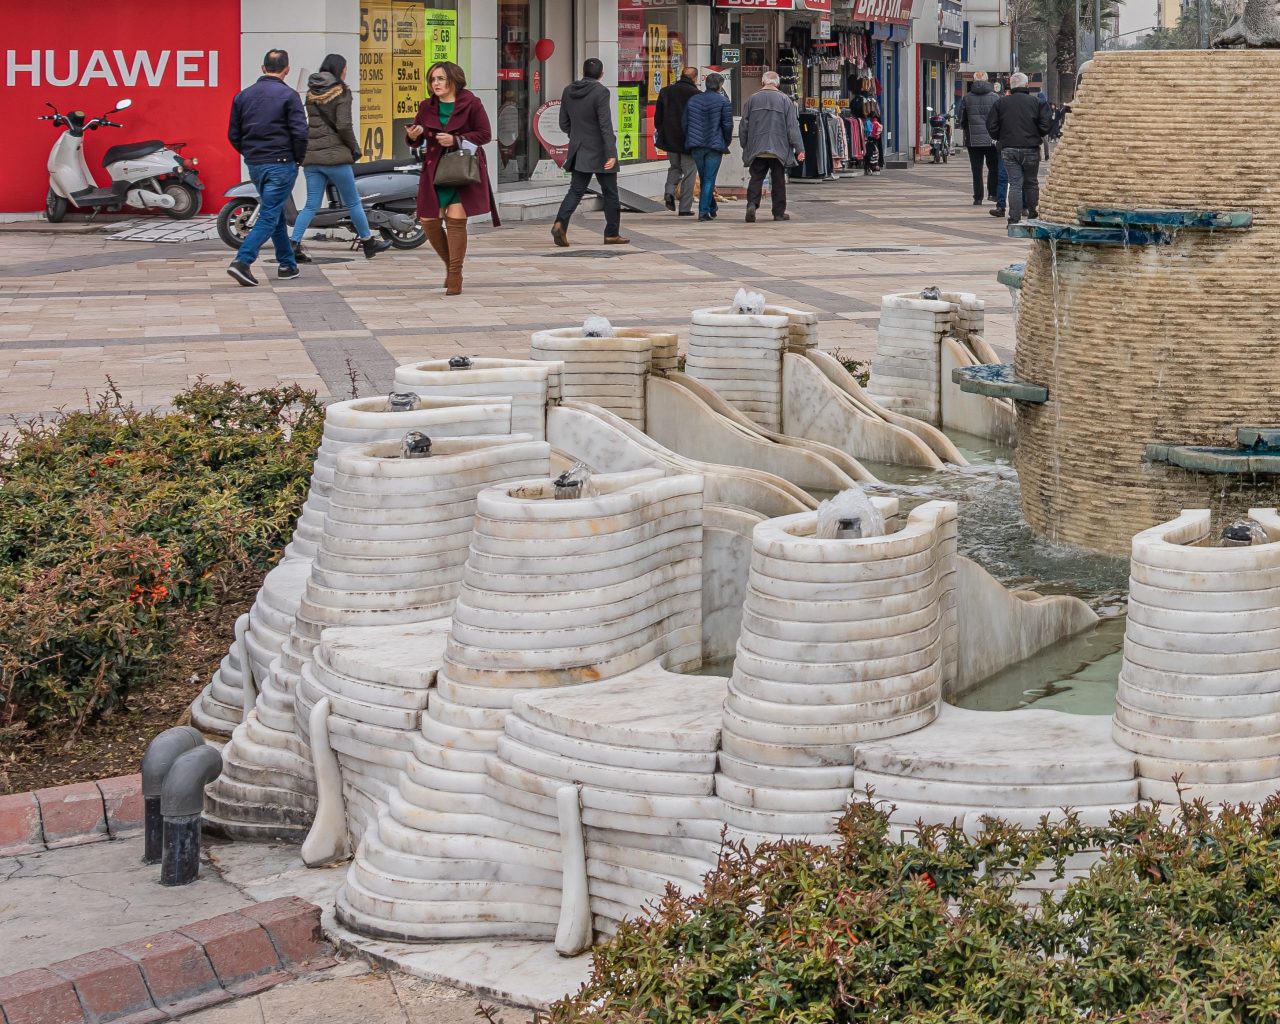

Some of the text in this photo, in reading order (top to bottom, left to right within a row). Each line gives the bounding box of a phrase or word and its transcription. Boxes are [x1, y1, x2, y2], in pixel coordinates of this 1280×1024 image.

[373, 18, 388, 42] GB
[433, 29, 449, 42] 5 GB
[650, 27, 660, 53] 12
[374, 53, 383, 65] DK
[6, 49, 219, 88] HUAWEI
[369, 69, 383, 81] SMS
[414, 68, 420, 81] tl
[397, 102, 413, 113] 69.90
[628, 104, 634, 114] GB
[364, 127, 384, 161] 49
